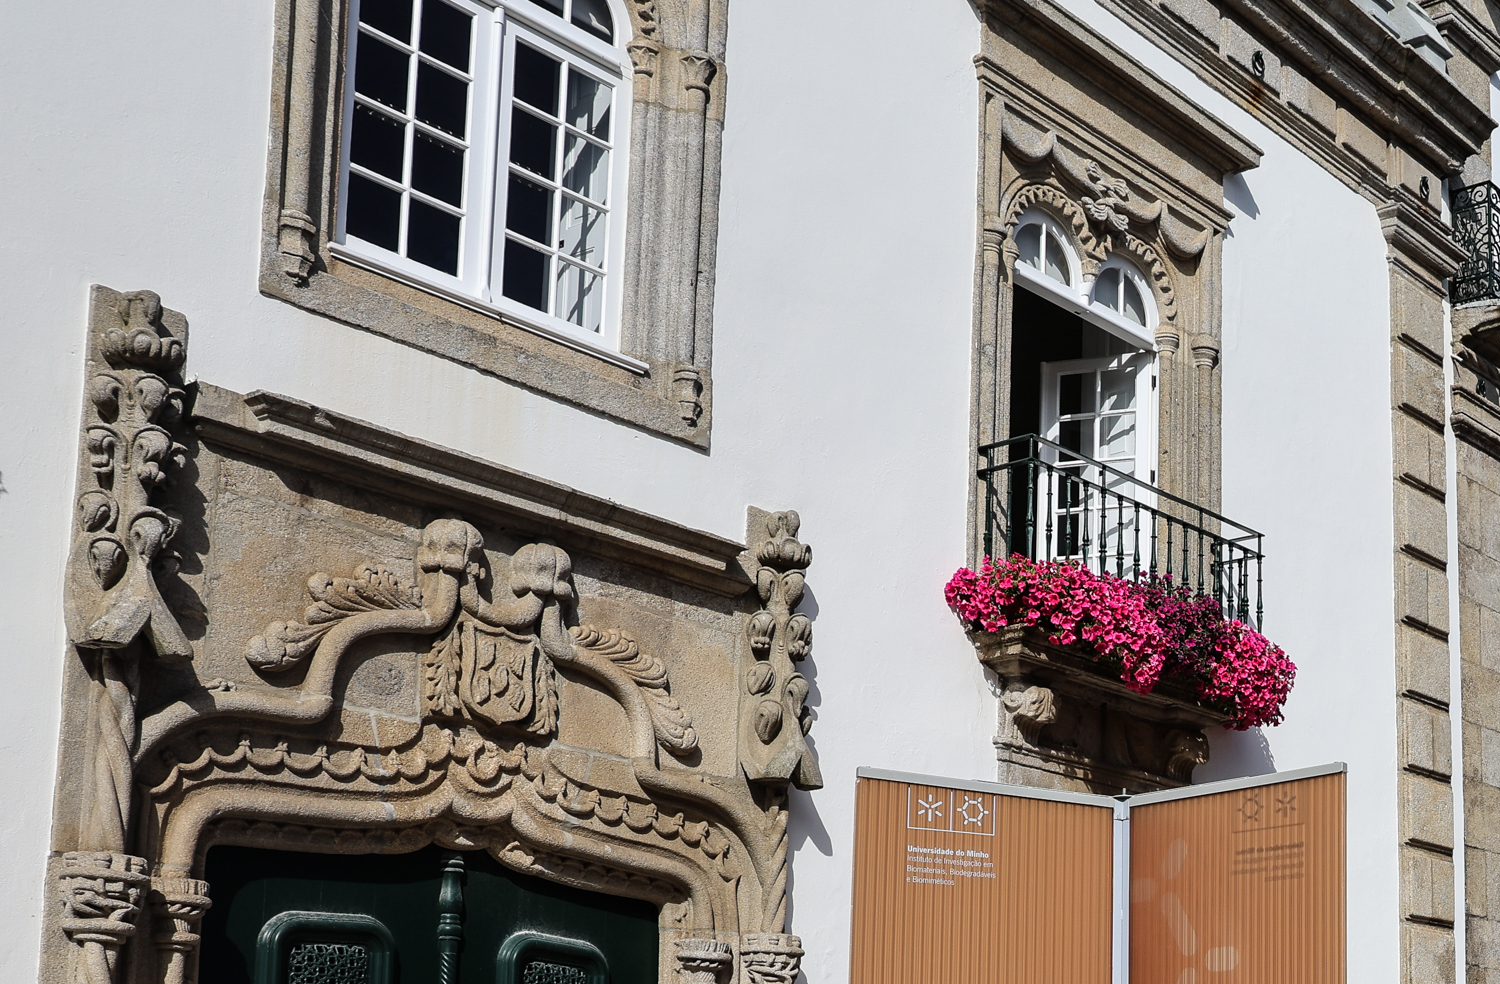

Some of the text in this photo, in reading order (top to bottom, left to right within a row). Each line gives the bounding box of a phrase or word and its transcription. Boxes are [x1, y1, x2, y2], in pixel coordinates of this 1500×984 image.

[908, 845, 954, 855] Universidade
[967, 850, 989, 858] Minho
[907, 855, 932, 863] Instituto
[944, 858, 982, 868] Investigação
[907, 865, 996, 879] Biomateriais, Biodegradáveis
[913, 876, 954, 885] Biomiméticos
